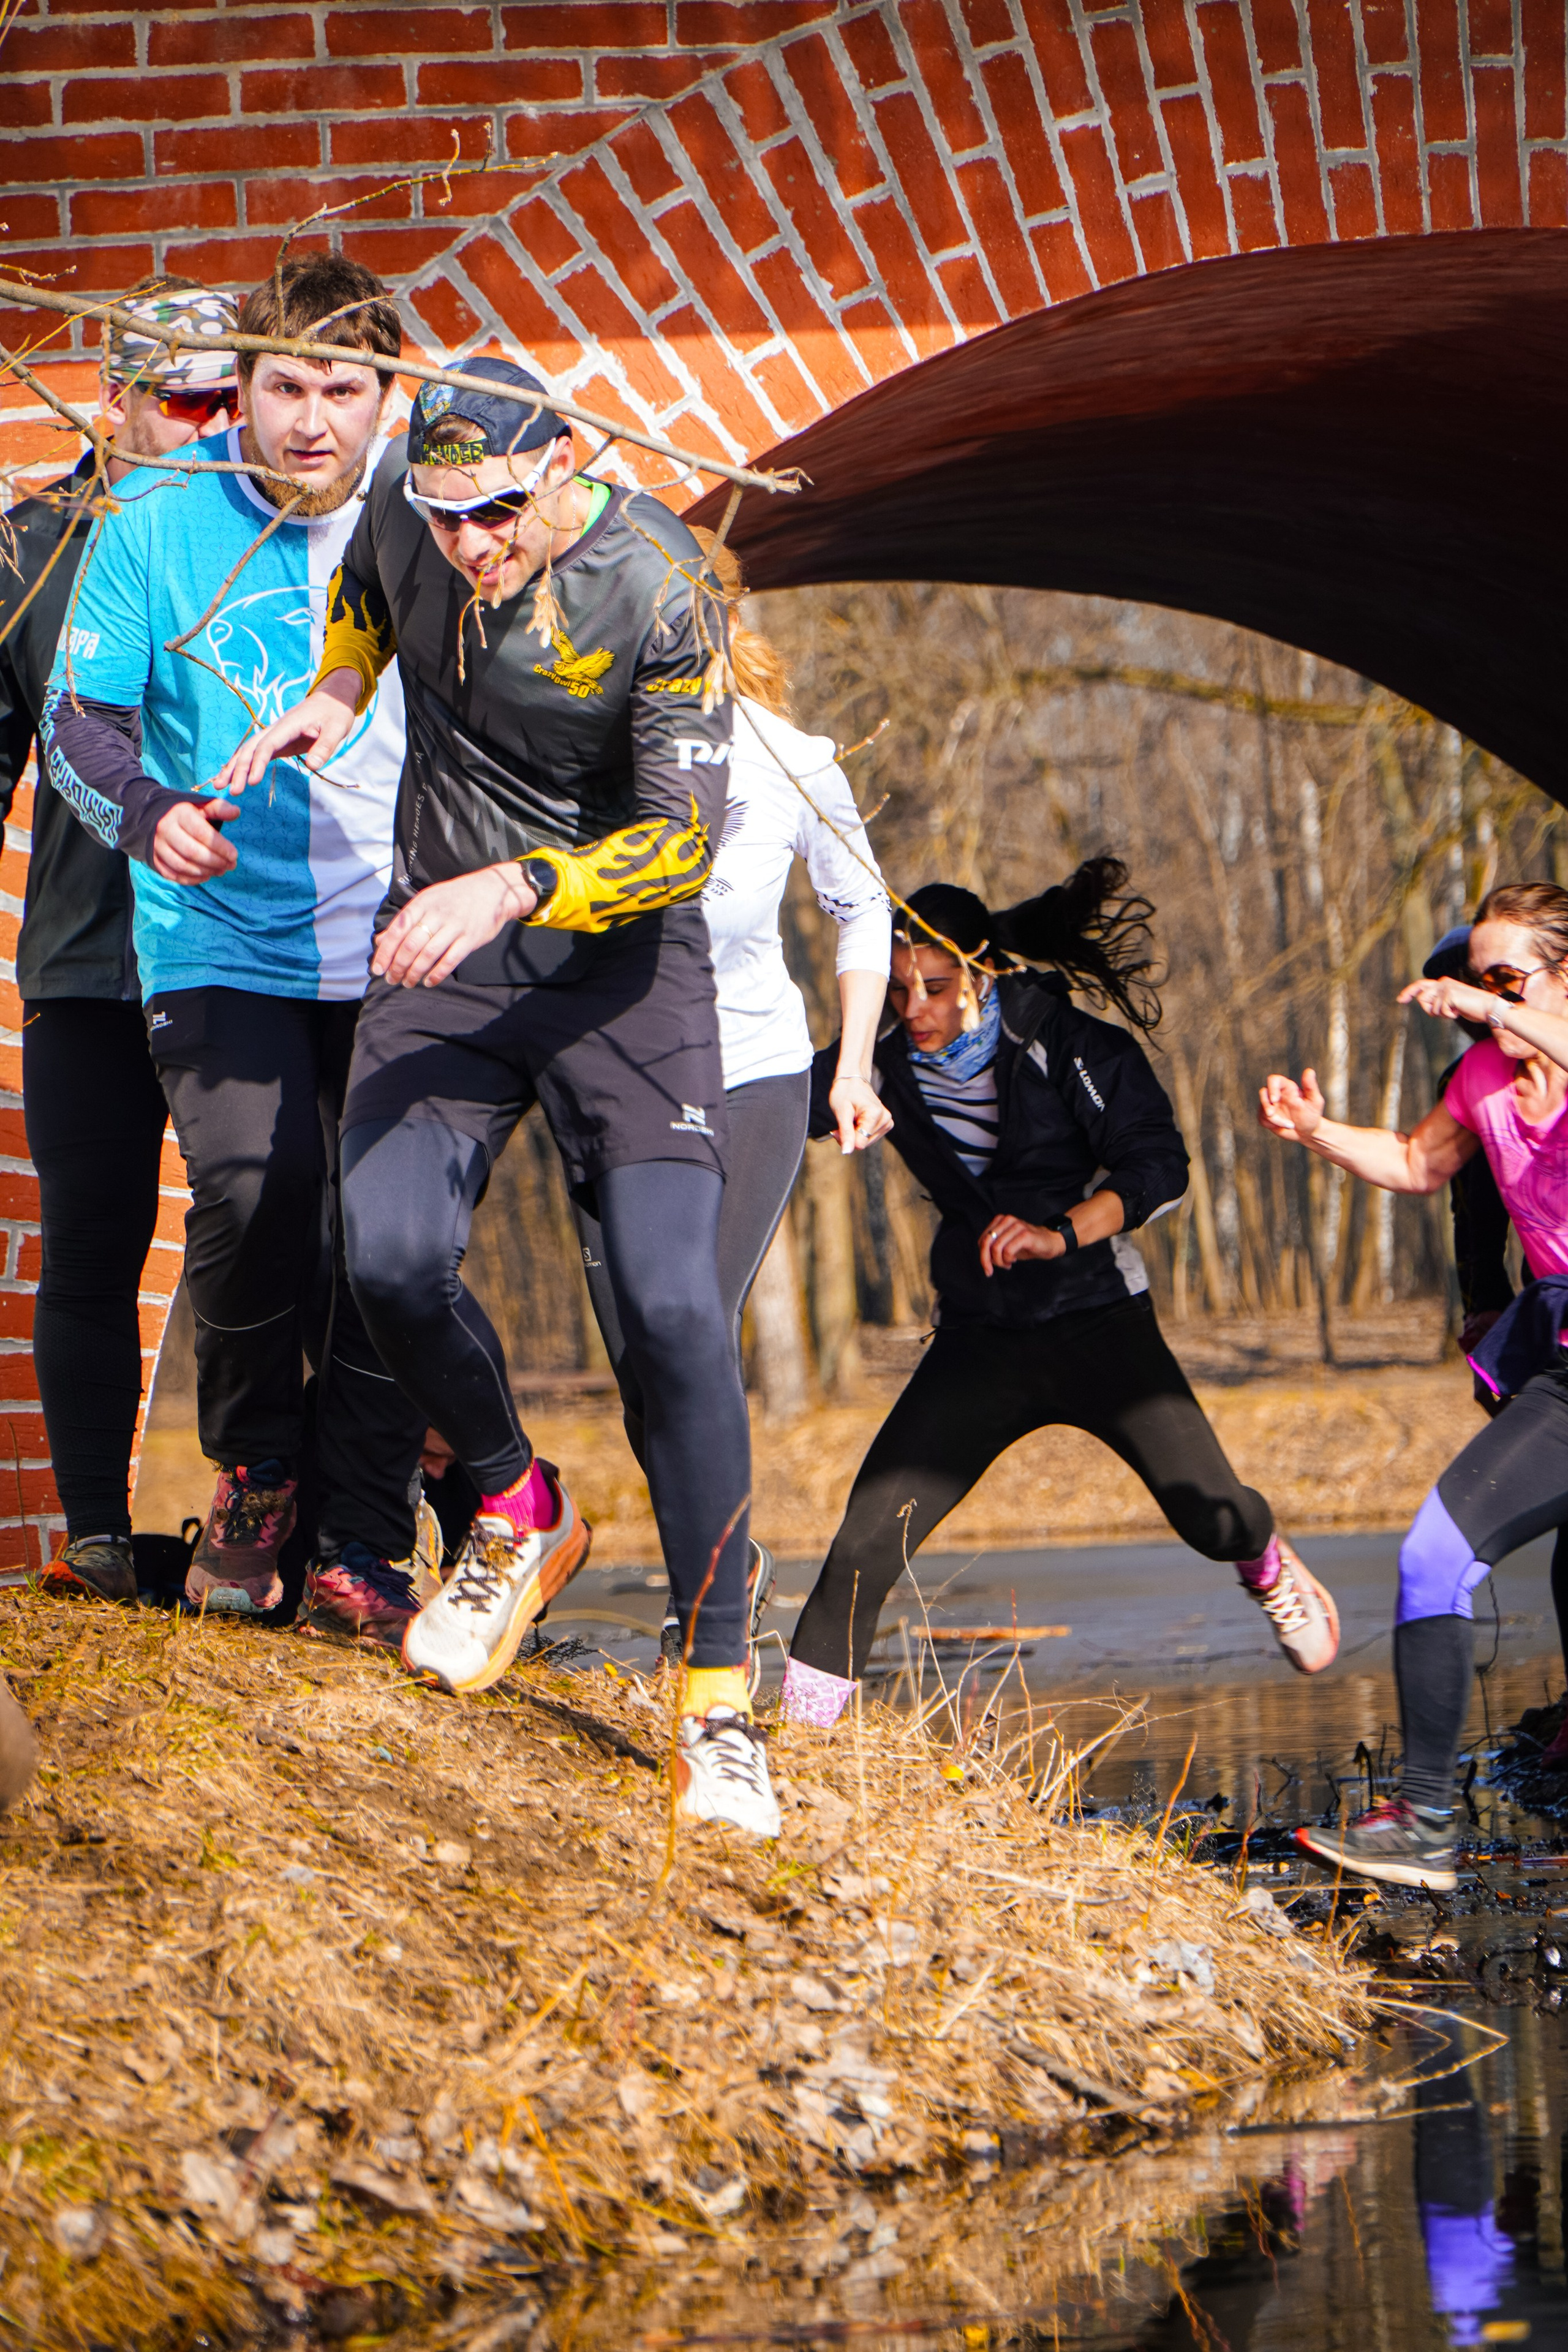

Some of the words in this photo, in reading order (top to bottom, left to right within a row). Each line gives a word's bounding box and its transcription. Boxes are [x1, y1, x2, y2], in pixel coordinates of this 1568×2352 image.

[533, 663, 557, 679] Crazy
[554, 676, 571, 687] Owl
[568, 681, 590, 698] 50
[670, 1121, 715, 1136] NORDSKI
